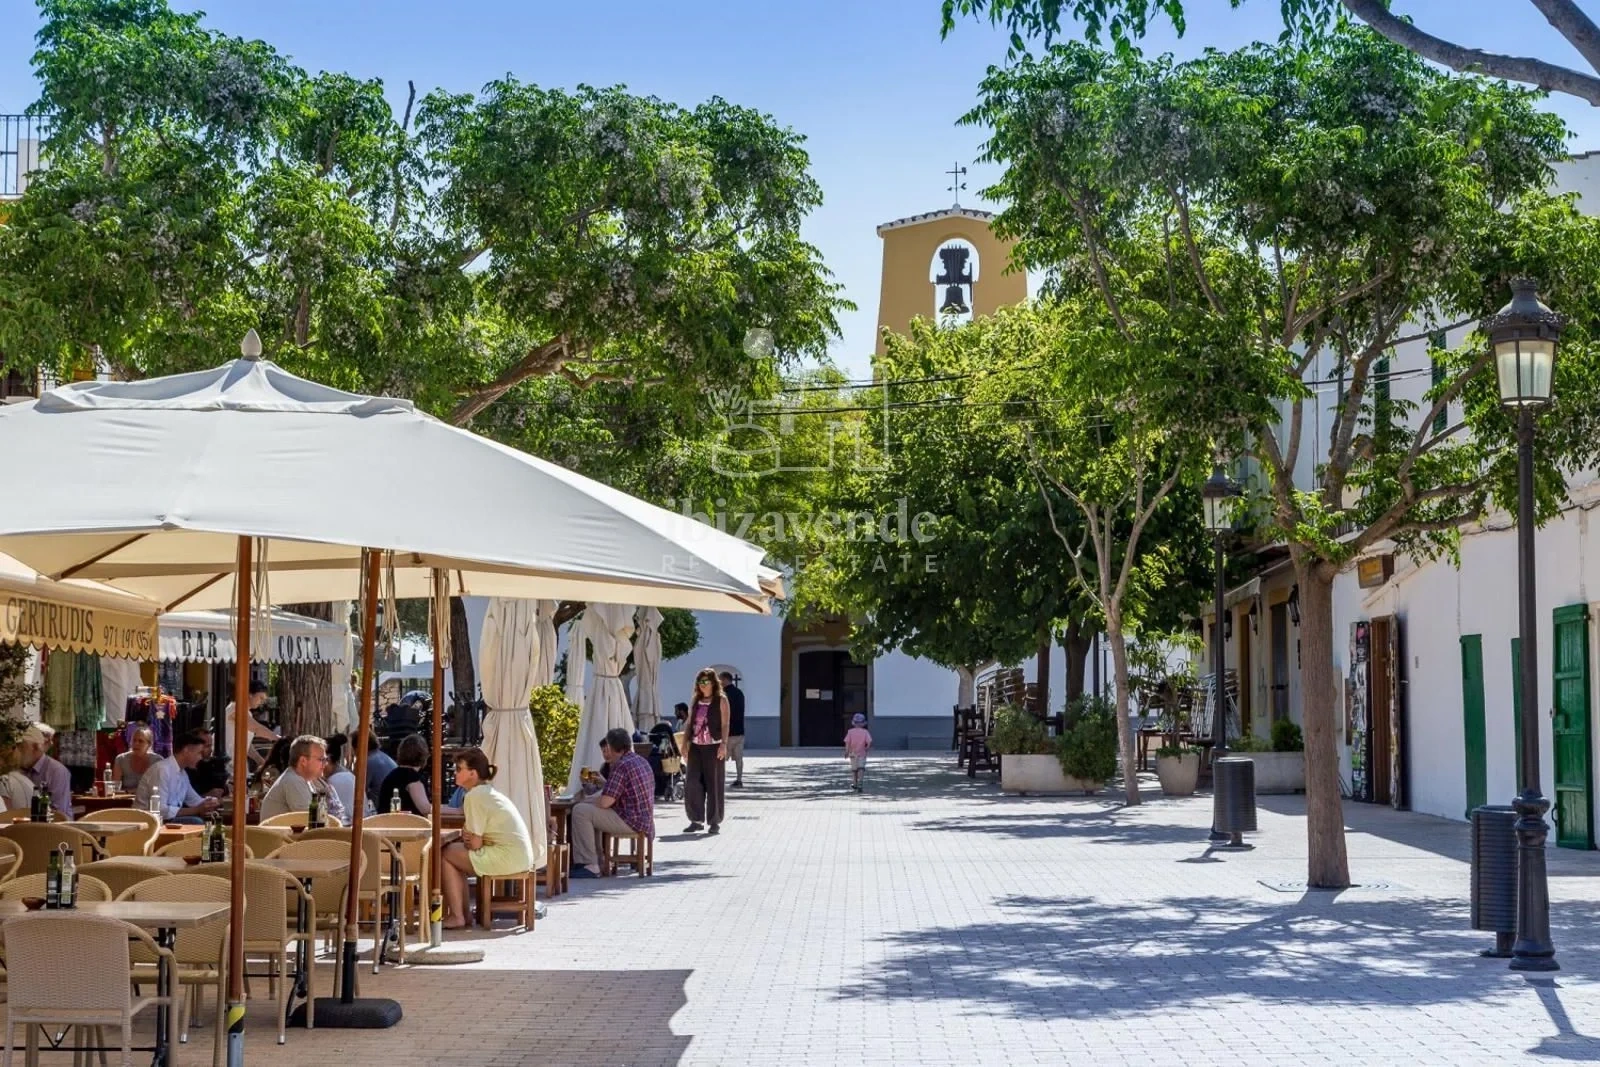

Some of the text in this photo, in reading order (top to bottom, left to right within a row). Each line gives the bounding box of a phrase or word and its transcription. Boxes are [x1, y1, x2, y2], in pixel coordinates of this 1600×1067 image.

[6, 597, 94, 644] GERTRUDIS
[103, 624, 118, 647] 971
[122, 627, 136, 648] 197
[181, 629, 321, 660] BAR COSTA
